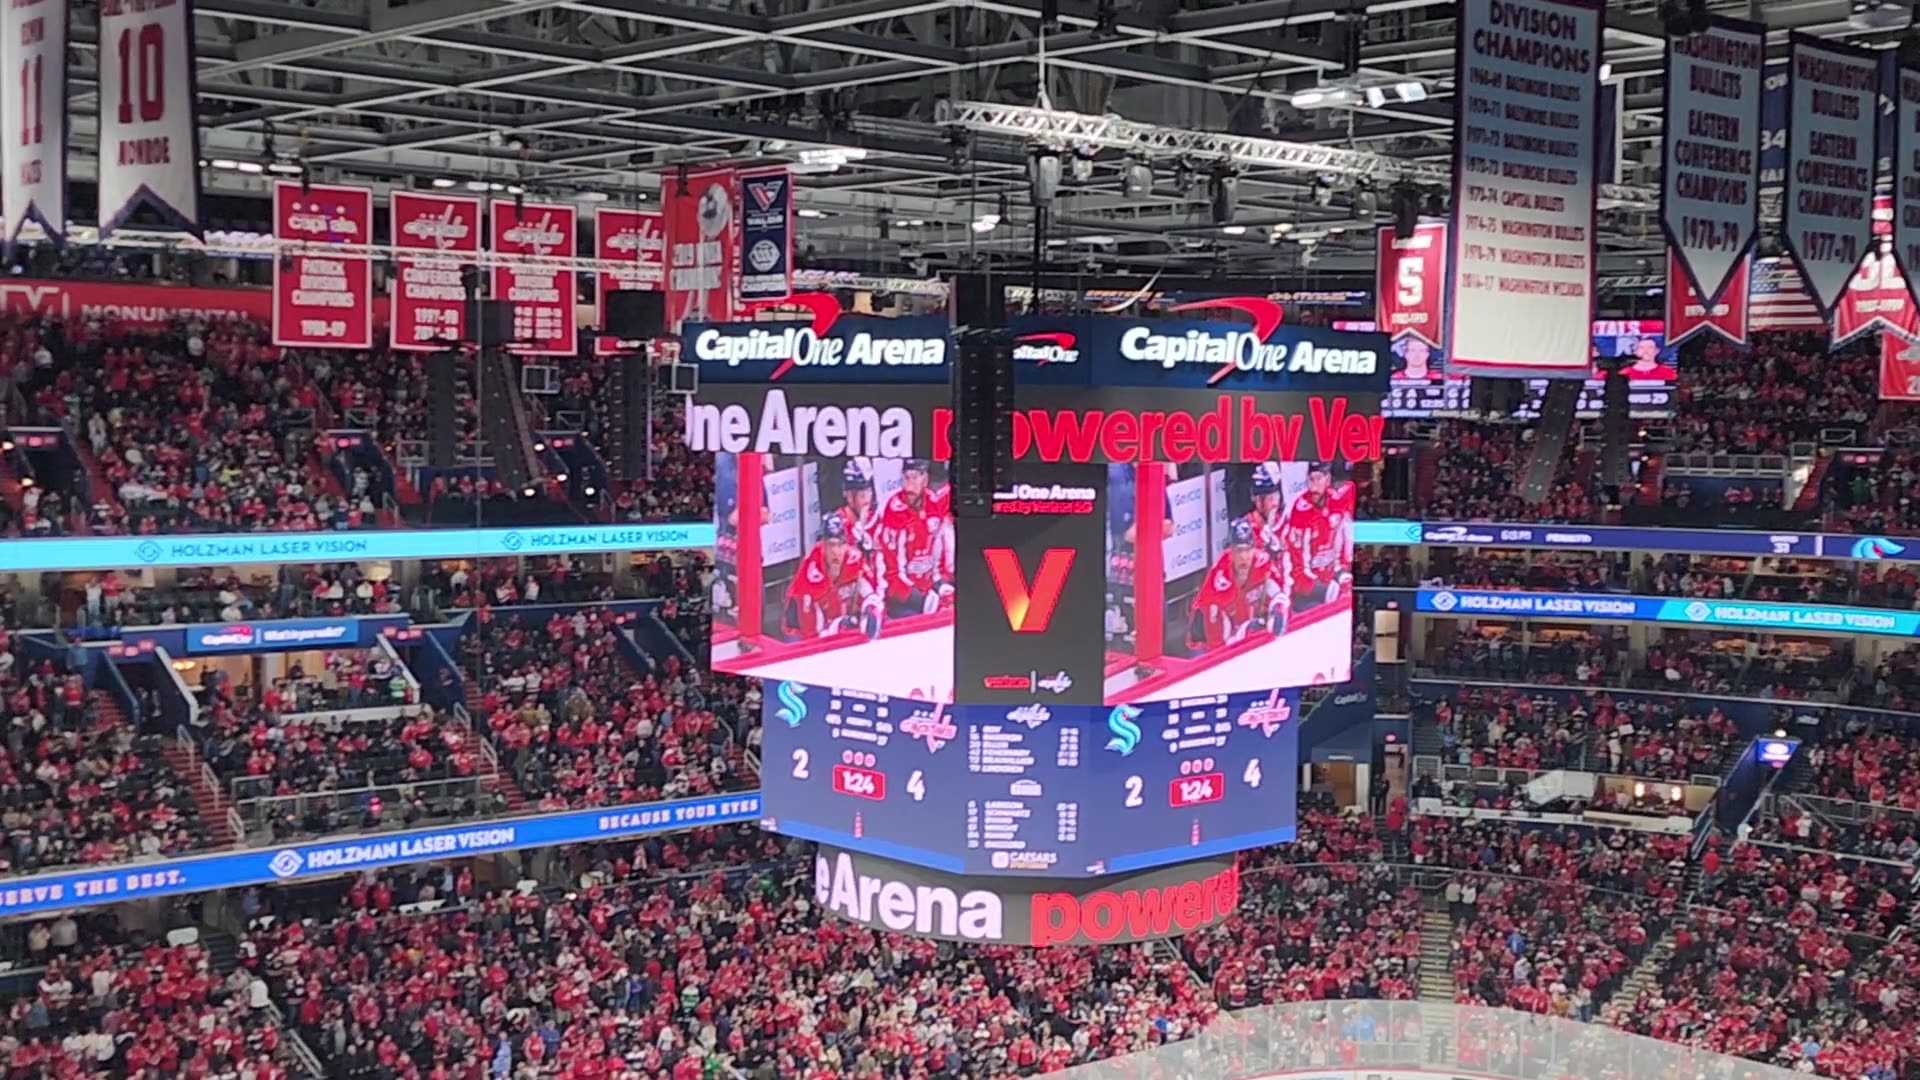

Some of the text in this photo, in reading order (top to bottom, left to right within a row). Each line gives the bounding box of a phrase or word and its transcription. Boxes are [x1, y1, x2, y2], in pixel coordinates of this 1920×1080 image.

[1490, 1, 1577, 41] DIVISION
[1473, 28, 1590, 74] CHAMPIONS
[118, 23, 164, 123] 10
[1690, 63, 1742, 99] BULLETS
[21, 54, 43, 146] 11
[1812, 88, 1859, 120] BULLETS
[1688, 109, 1740, 142] EASTERN
[119, 136, 170, 166] MONROE
[1675, 139, 1751, 174] CONFERENCE
[1810, 131, 1857, 160] EASTERN
[1677, 171, 1747, 205] CHAMPIONS
[1796, 159, 1868, 191] CONFERENCE
[1798, 189, 1864, 220] CHAMPIONS
[1502, 219, 1552, 239] WASHINGTON
[1501, 247, 1551, 266] WASHINGTON
[1398, 257, 1424, 306] 5
[1499, 276, 1550, 295] WASHINGTON
[846, 333, 946, 366] Arena
[1287, 342, 1377, 374] Arena
[755, 388, 913, 458] Arena
[1017, 484, 1096, 500] One Arena
[171, 539, 367, 557] HOLZMAN LASER VISION
[531, 529, 689, 547] HOLZMAN LASER VISION
[1460, 596, 1635, 614] HOLZMAN LASER VISION
[1715, 606, 1895, 628] HOLZMAN LASER VISION
[791, 748, 926, 801] 2 4
[1124, 758, 1262, 807] 2 4
[600, 799, 759, 831] BECAUSE YOUR EYES
[308, 828, 515, 869] HOLZMAN LASER VISION
[1009, 852, 1058, 864] CAESARS
[0, 870, 187, 906] ERVE THE BEST.
[830, 852, 1002, 939] Arena
